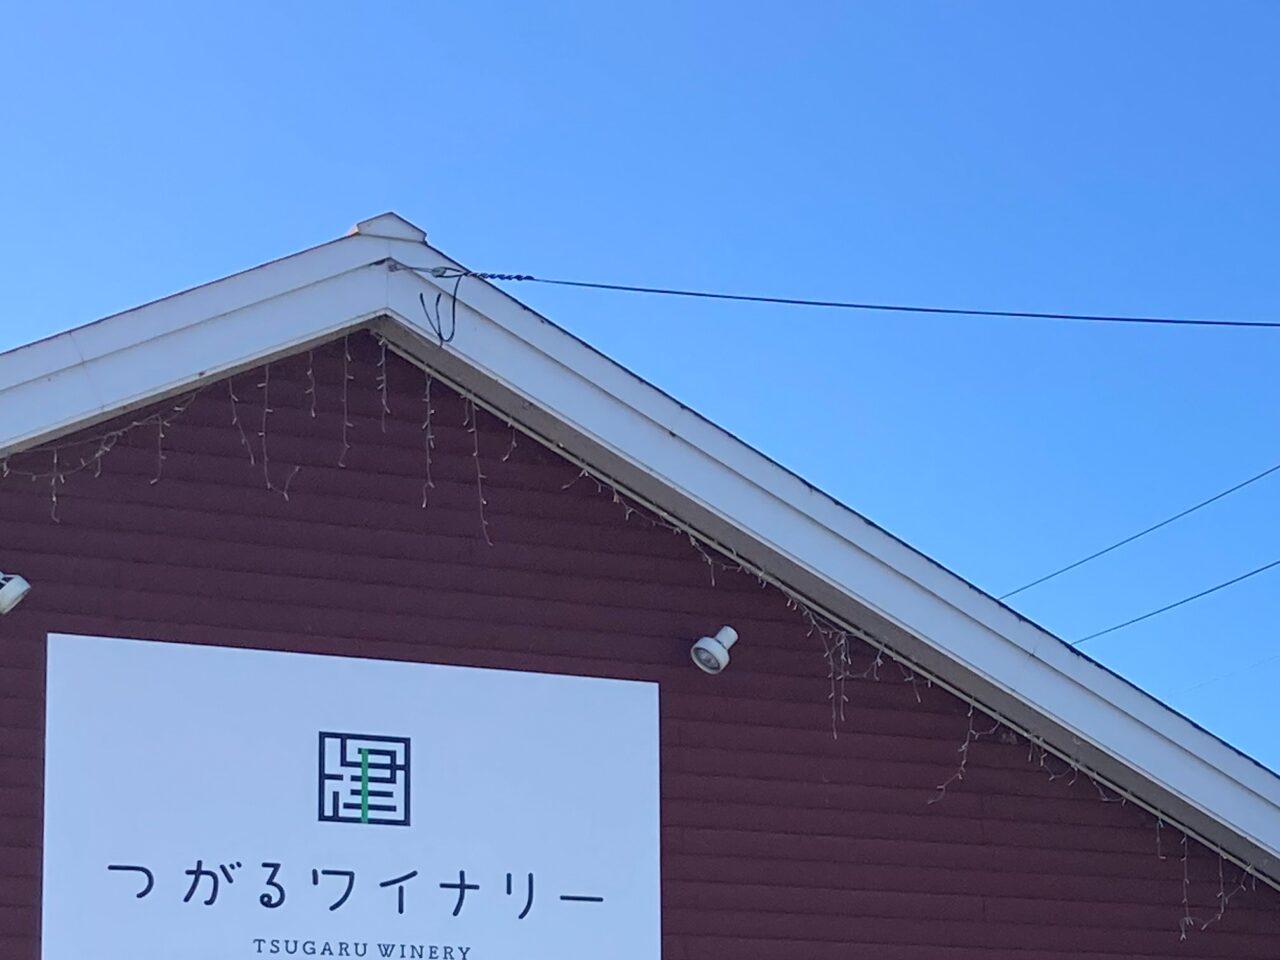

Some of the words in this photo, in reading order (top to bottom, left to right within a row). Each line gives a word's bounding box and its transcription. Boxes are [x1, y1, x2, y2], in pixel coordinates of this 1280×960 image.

[107, 859, 604, 920] つがるワイナリー
[252, 938, 369, 958] TSUGARU
